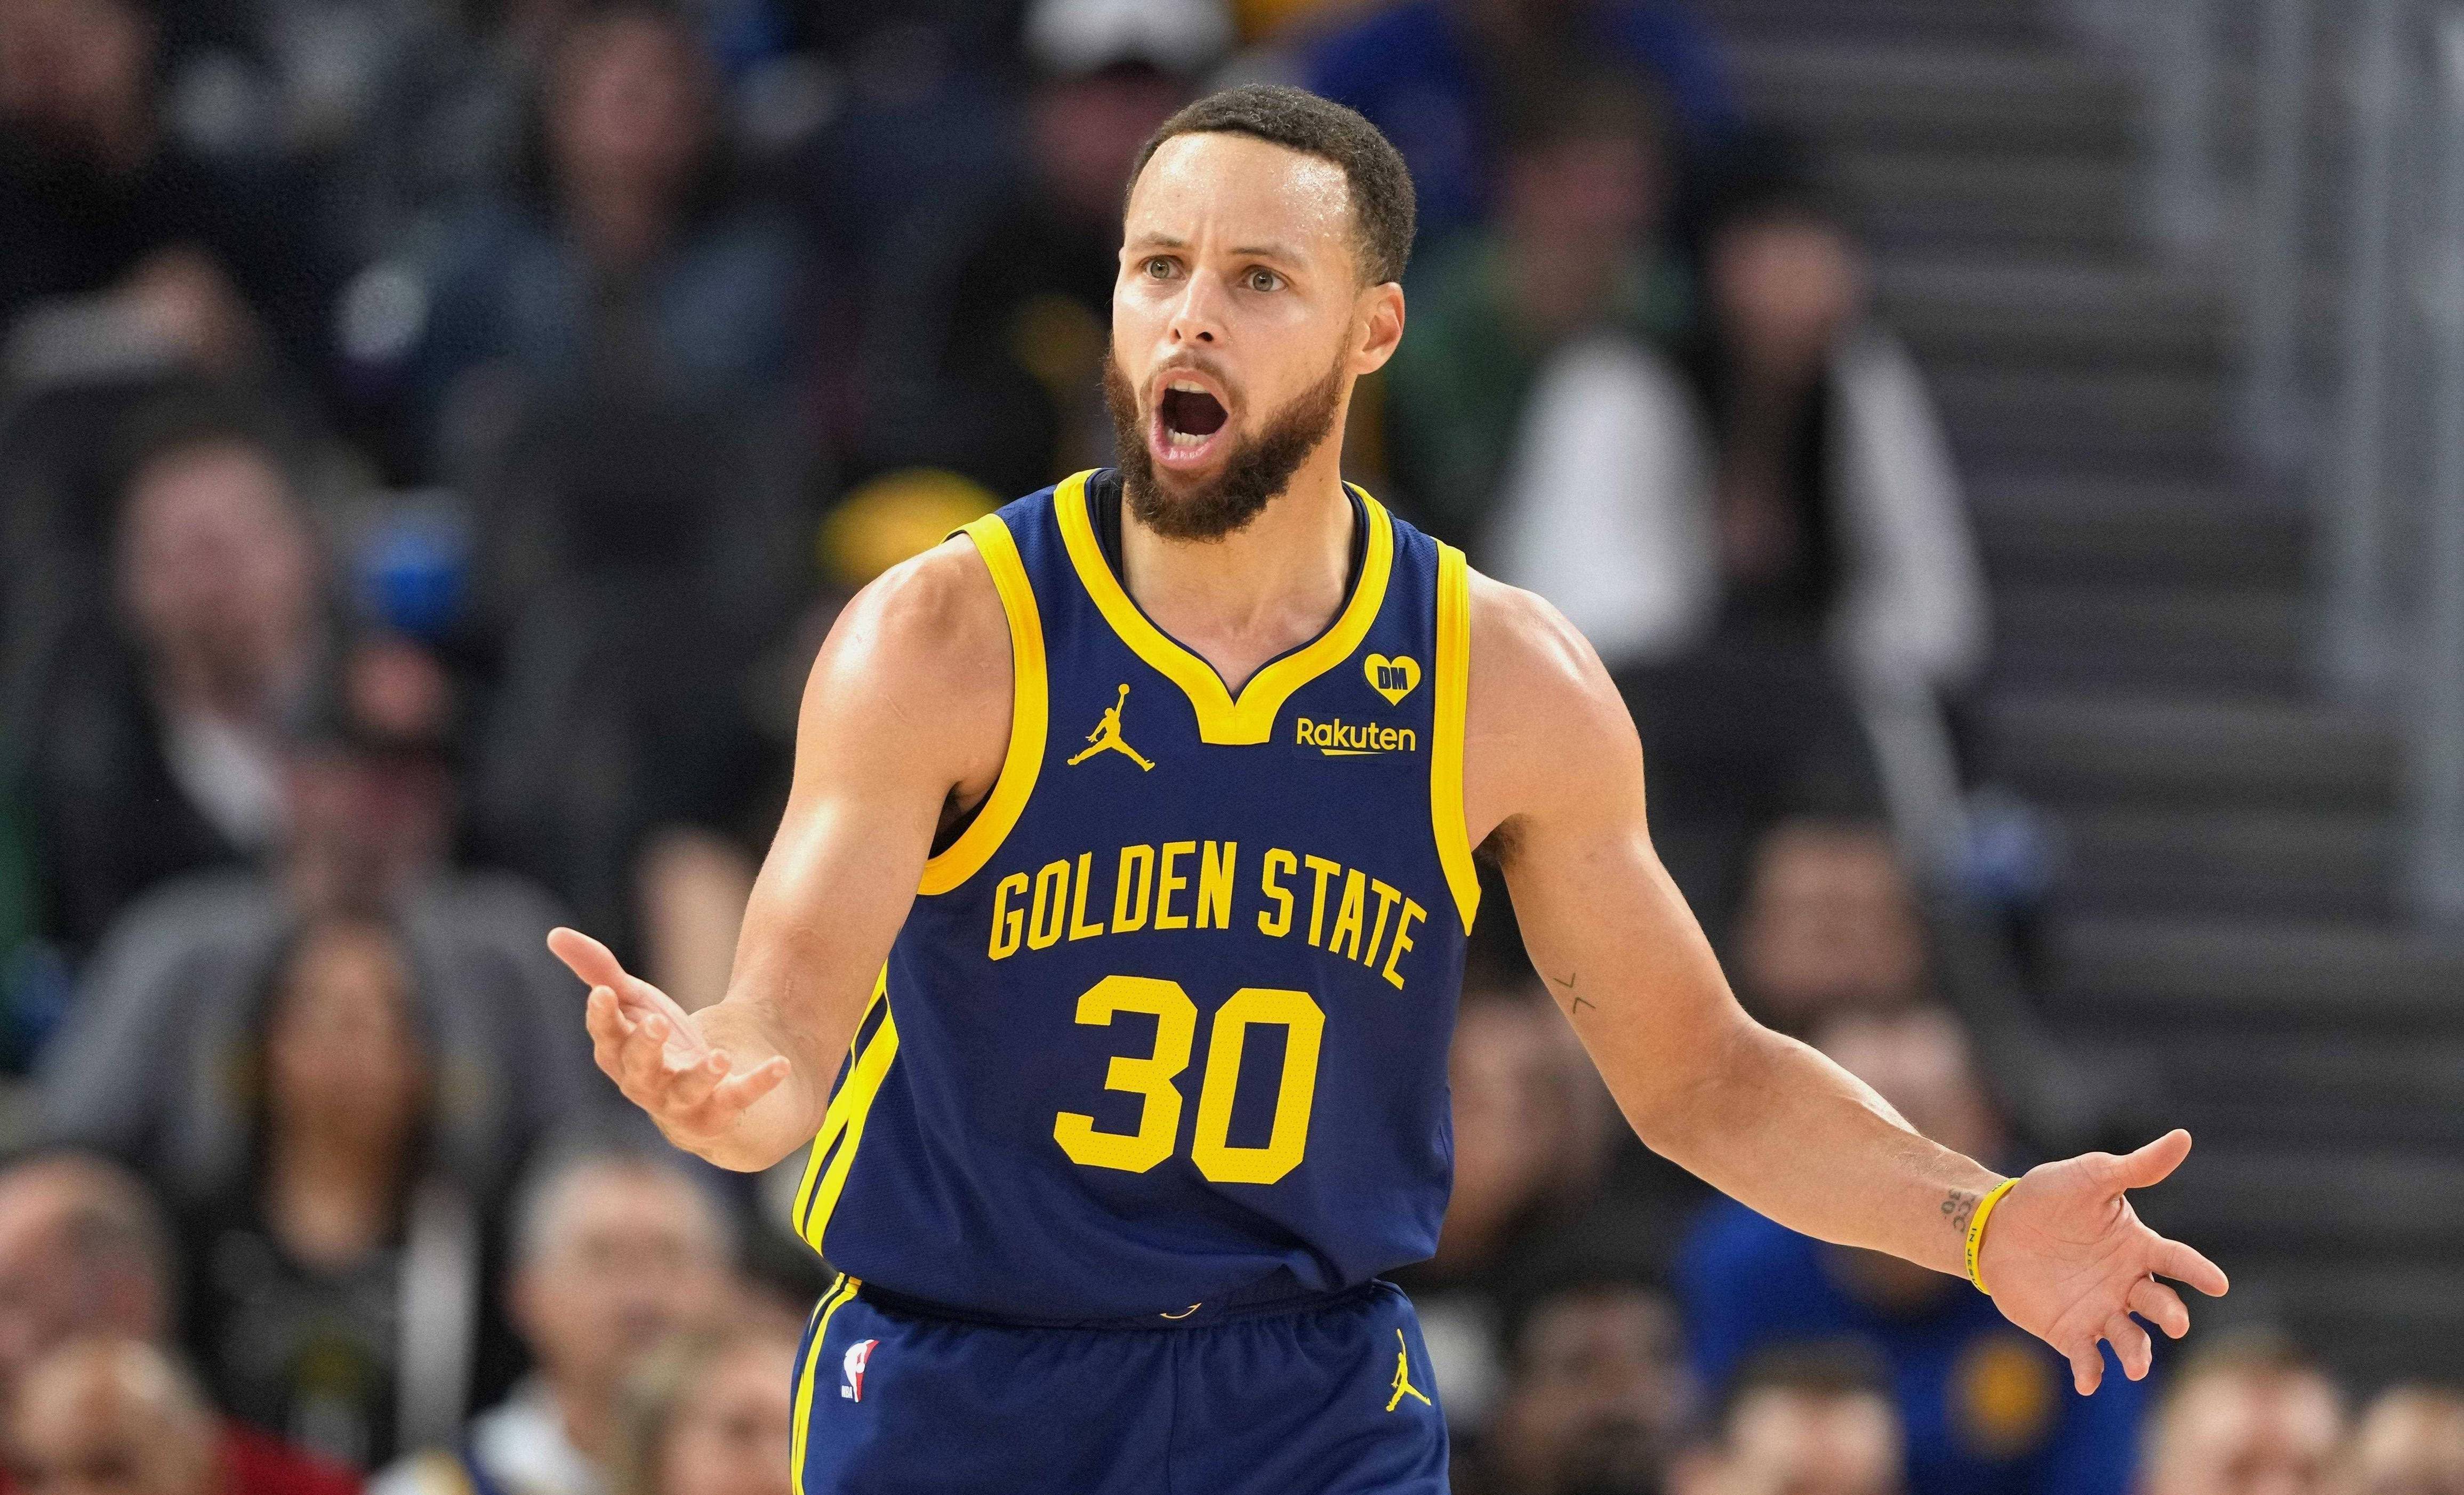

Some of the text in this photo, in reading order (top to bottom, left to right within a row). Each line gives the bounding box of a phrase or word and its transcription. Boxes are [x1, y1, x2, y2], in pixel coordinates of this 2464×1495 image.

[1377, 665, 1408, 690] DM
[1296, 718, 1416, 751] Rakuten
[988, 840, 1428, 991] GOLDEN STATE
[1053, 975, 1326, 1185] 30
[1969, 1227, 1977, 1242] IN
[841, 1385, 853, 1398] NBA
